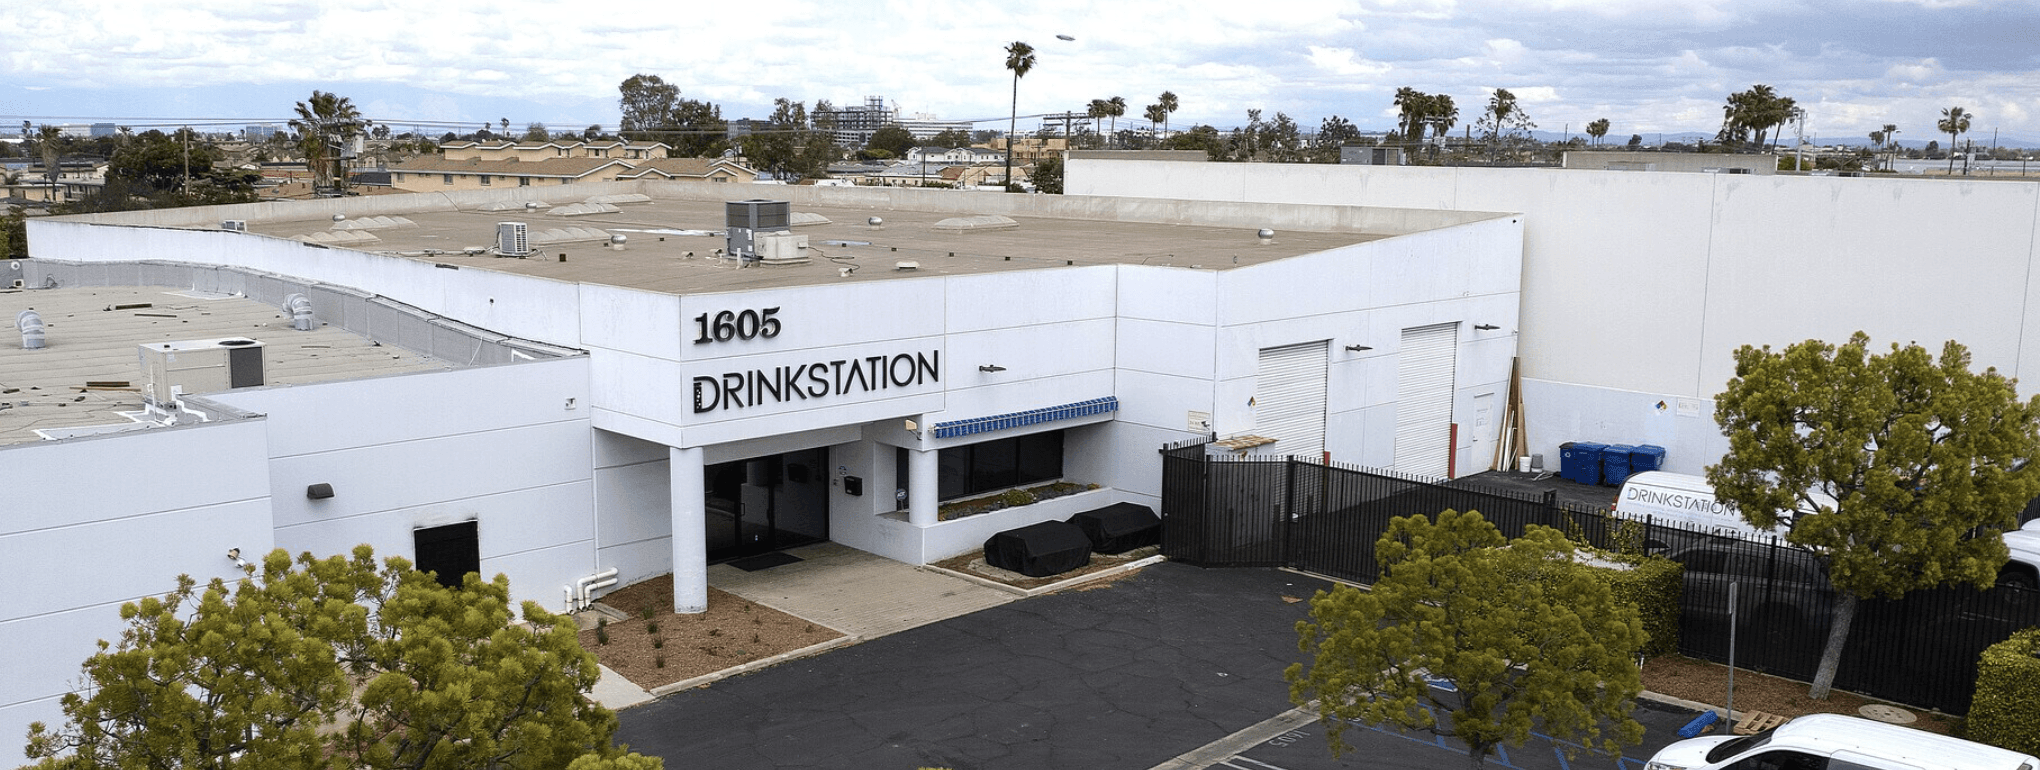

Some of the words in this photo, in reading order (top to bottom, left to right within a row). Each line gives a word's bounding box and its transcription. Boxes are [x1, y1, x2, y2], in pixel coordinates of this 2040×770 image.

[693, 306, 782, 345] 1605
[693, 350, 939, 414] DRINKSTATION
[1627, 487, 1736, 516] DRINKSTATION
